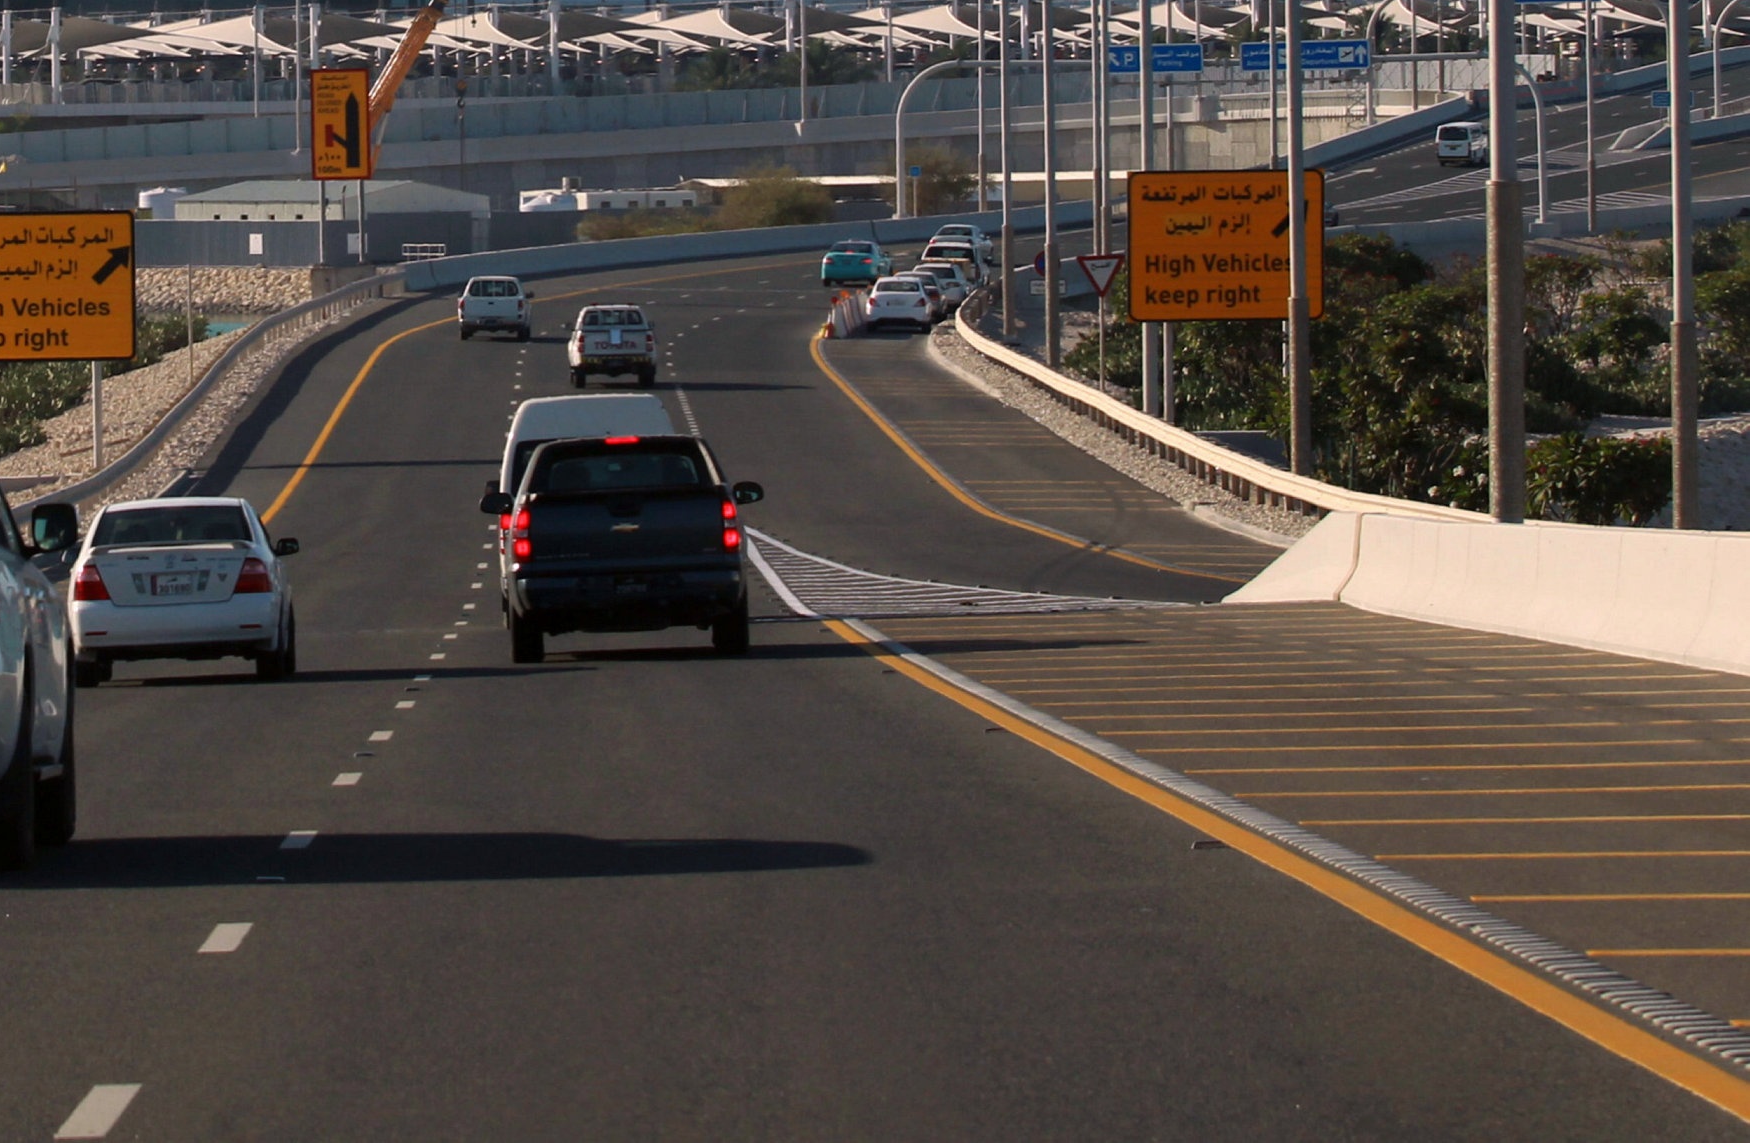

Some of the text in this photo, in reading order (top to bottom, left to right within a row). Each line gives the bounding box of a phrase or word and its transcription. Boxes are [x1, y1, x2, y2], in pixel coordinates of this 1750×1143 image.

[1124, 53, 1134, 66] P
[1141, 185, 1282, 205] المركبات المرتفعة
[1165, 215, 1212, 236] اليمين
[35, 227, 113, 249] المركبات
[1145, 254, 1290, 277] High Vehicles
[1145, 285, 1261, 307] keep right
[12, 297, 110, 317] Vehicles
[14, 328, 69, 351] right
